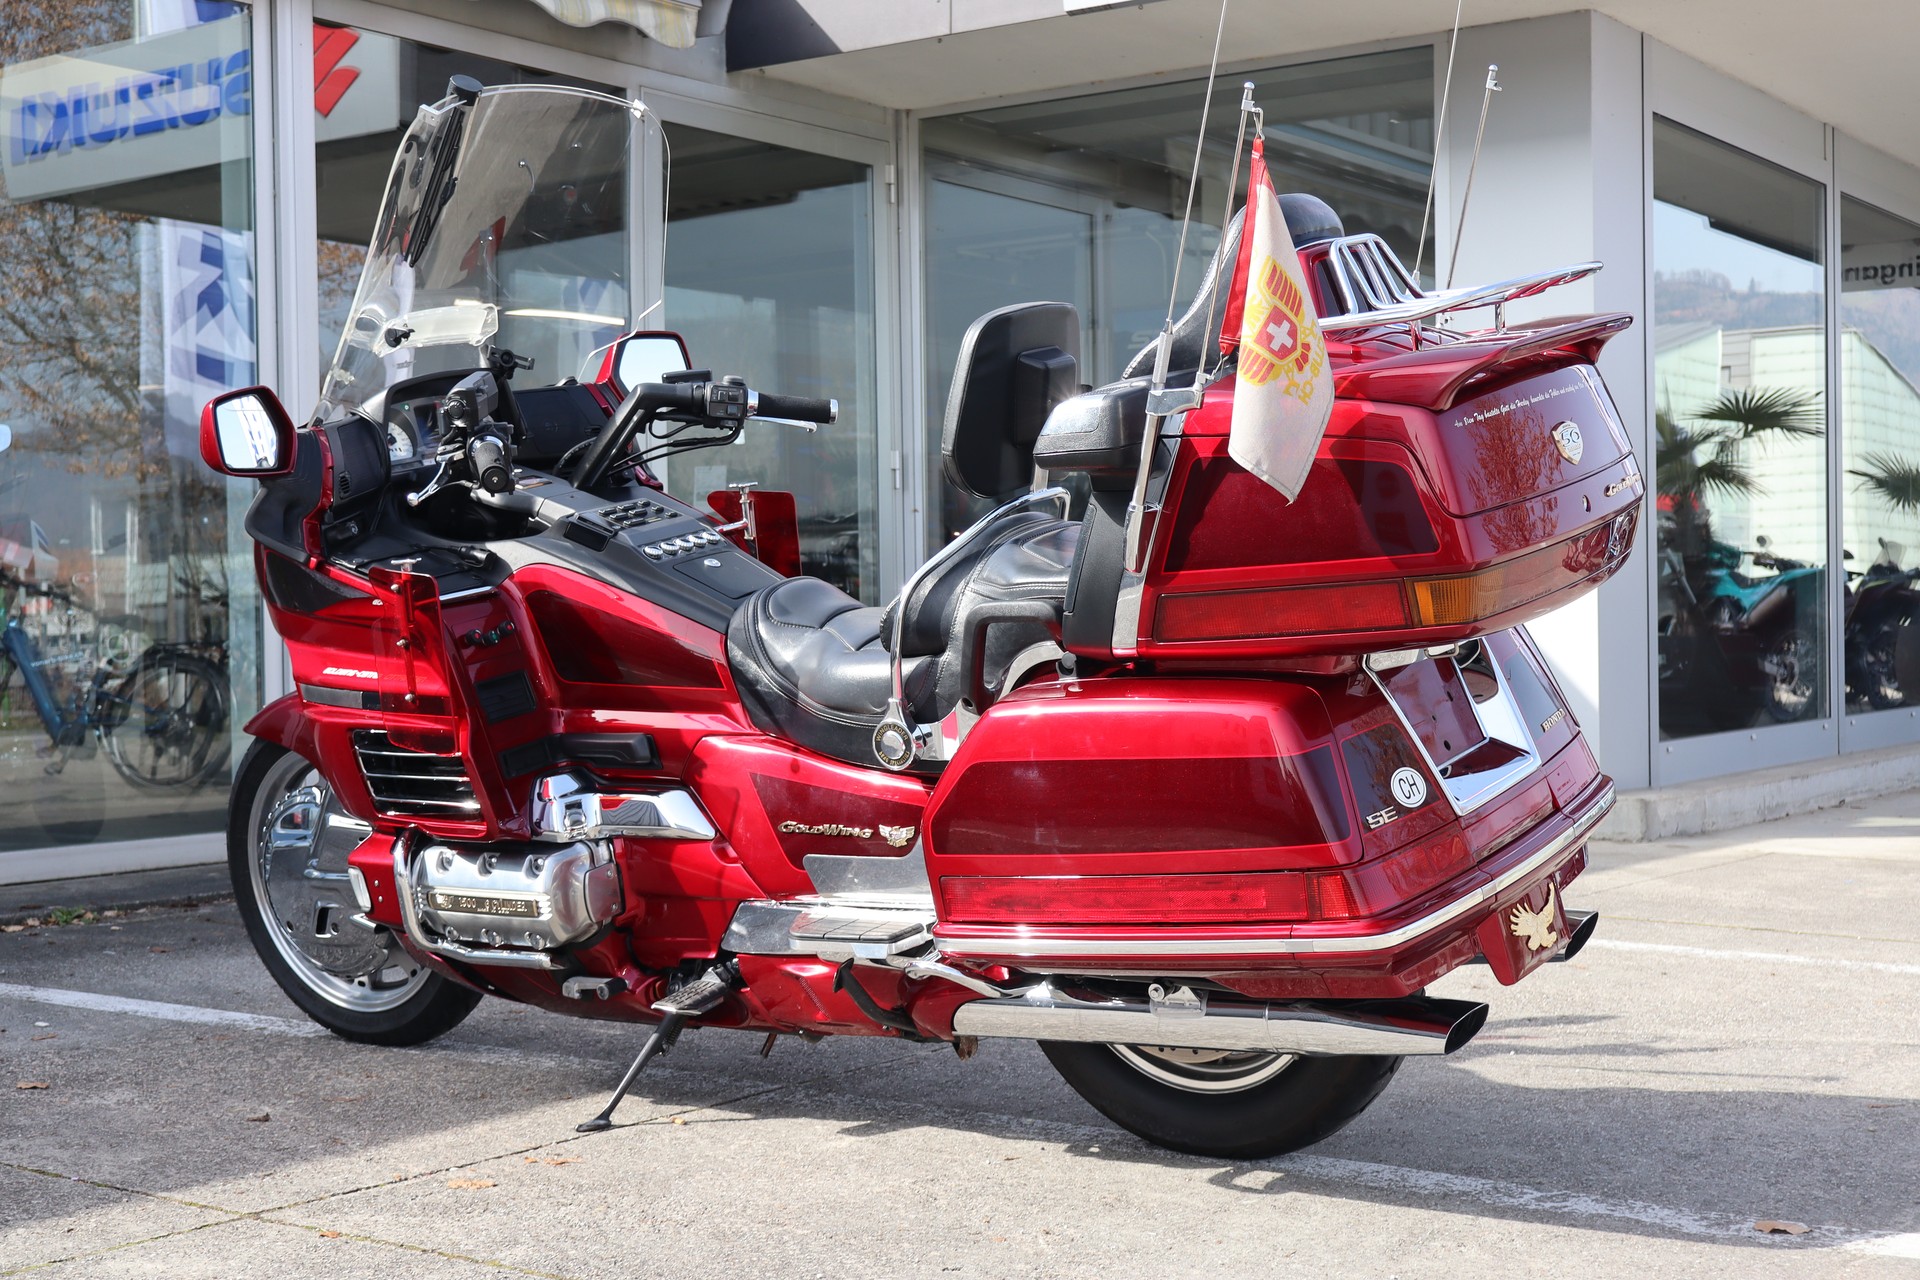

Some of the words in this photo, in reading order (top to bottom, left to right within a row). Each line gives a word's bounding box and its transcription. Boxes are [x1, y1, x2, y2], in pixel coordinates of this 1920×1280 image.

[876, 724, 909, 741] WINGLEADER
[1398, 774, 1421, 800] CH
[1366, 805, 1398, 829] SE
